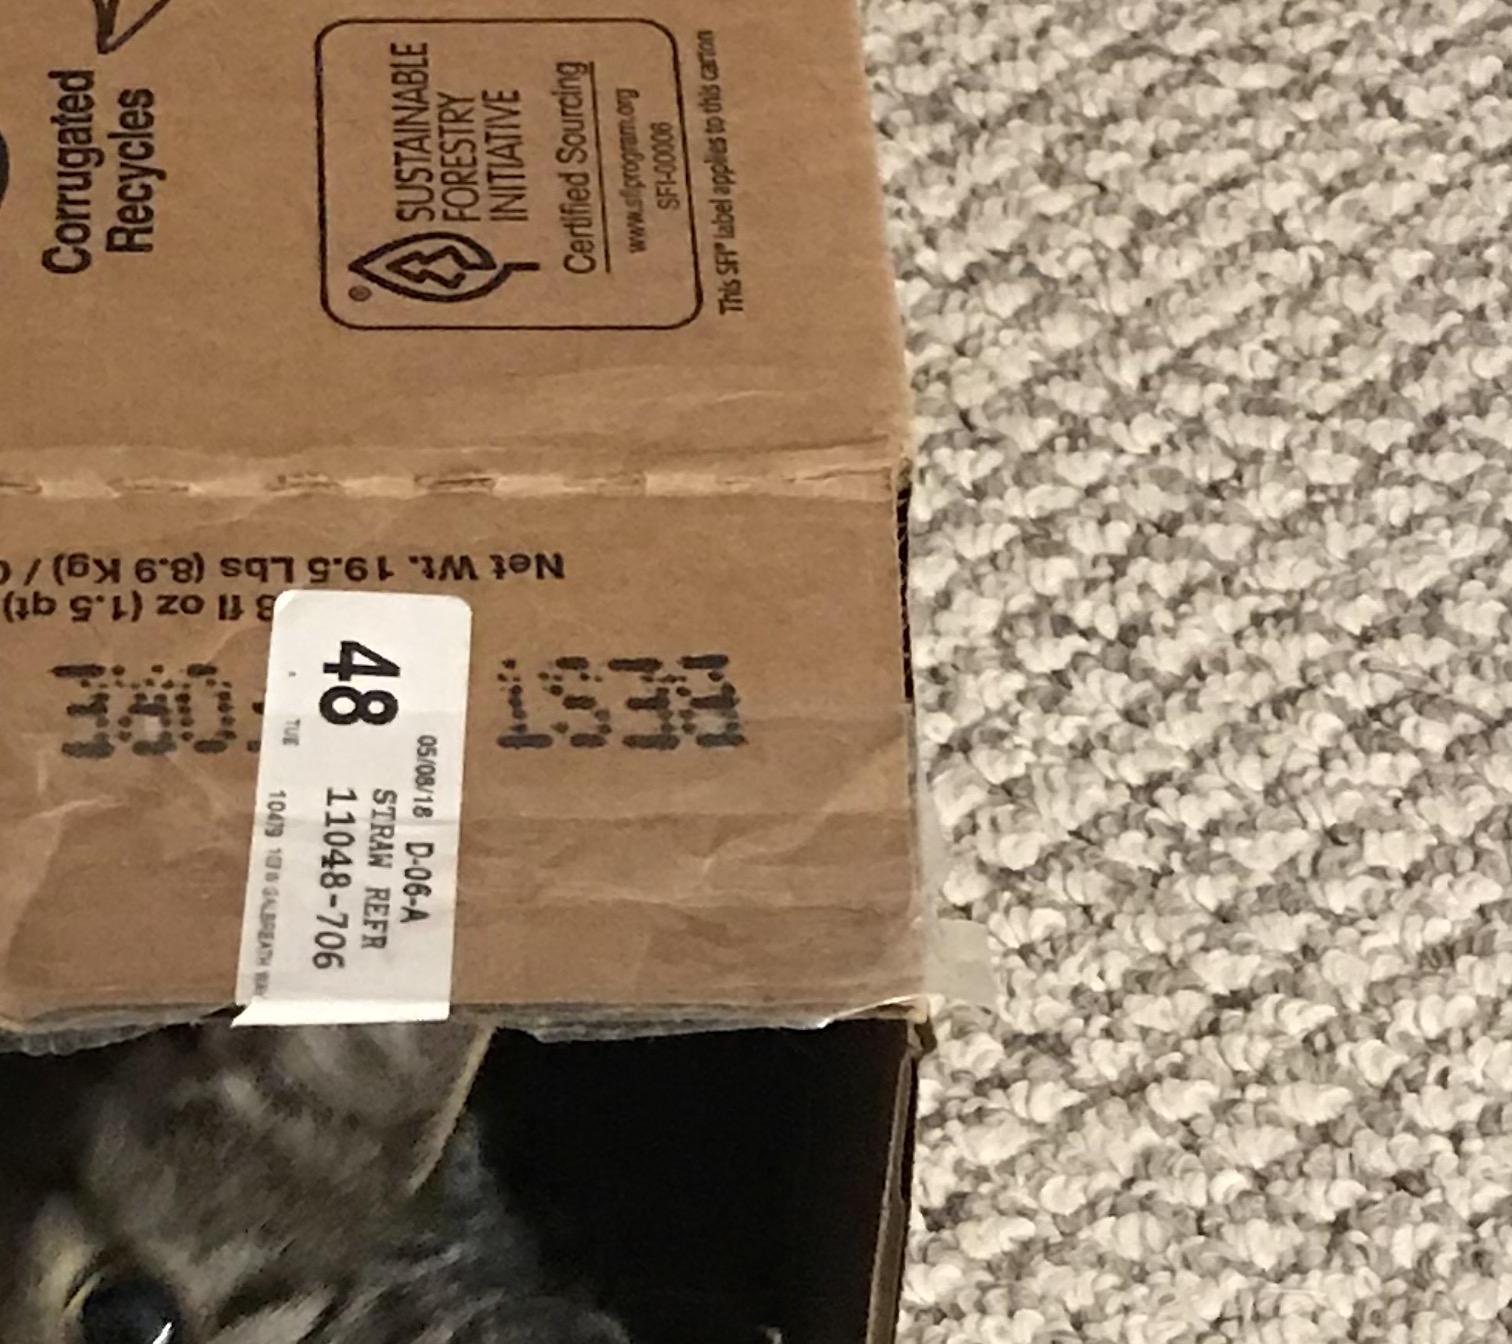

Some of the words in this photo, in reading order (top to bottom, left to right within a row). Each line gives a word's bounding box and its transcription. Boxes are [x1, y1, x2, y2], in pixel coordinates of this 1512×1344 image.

[696, 30, 719, 82] carton
[550, 60, 589, 165] Sourcing
[697, 84, 722, 114] this
[705, 116, 726, 134] to
[390, 42, 436, 223] SUSTAINABLE
[437, 90, 481, 223] FORESTRY
[482, 89, 528, 222] INITIATIVE
[41, 70, 105, 274] Corrugated
[105, 88, 167, 253] Recycles
[615, 87, 647, 255] www.sfiprogram.org
[703, 137, 736, 195] applies
[555, 174, 598, 275] Certified
[708, 199, 735, 239] label
[717, 278, 744, 316] This
[54, 552, 121, 585] Kg)
[135, 552, 204, 585] (8.9
[221, 553, 296, 582] Lbs
[309, 554, 394, 583] 19.5
[410, 554, 476, 580] Wt.
[491, 553, 565, 581] Net
[2, 591, 56, 622] qt)
[71, 593, 143, 624] (1.5
[158, 595, 205, 618] oz
[218, 594, 245, 621] fl
[317, 640, 402, 726] 48
[496, 654, 747, 750] BEST
[412, 735, 438, 820] 05/08/18
[367, 787, 398, 869] STRAW
[311, 787, 358, 972] 11048-706
[399, 841, 435, 925] D-06-A
[360, 887, 392, 951] REFR
